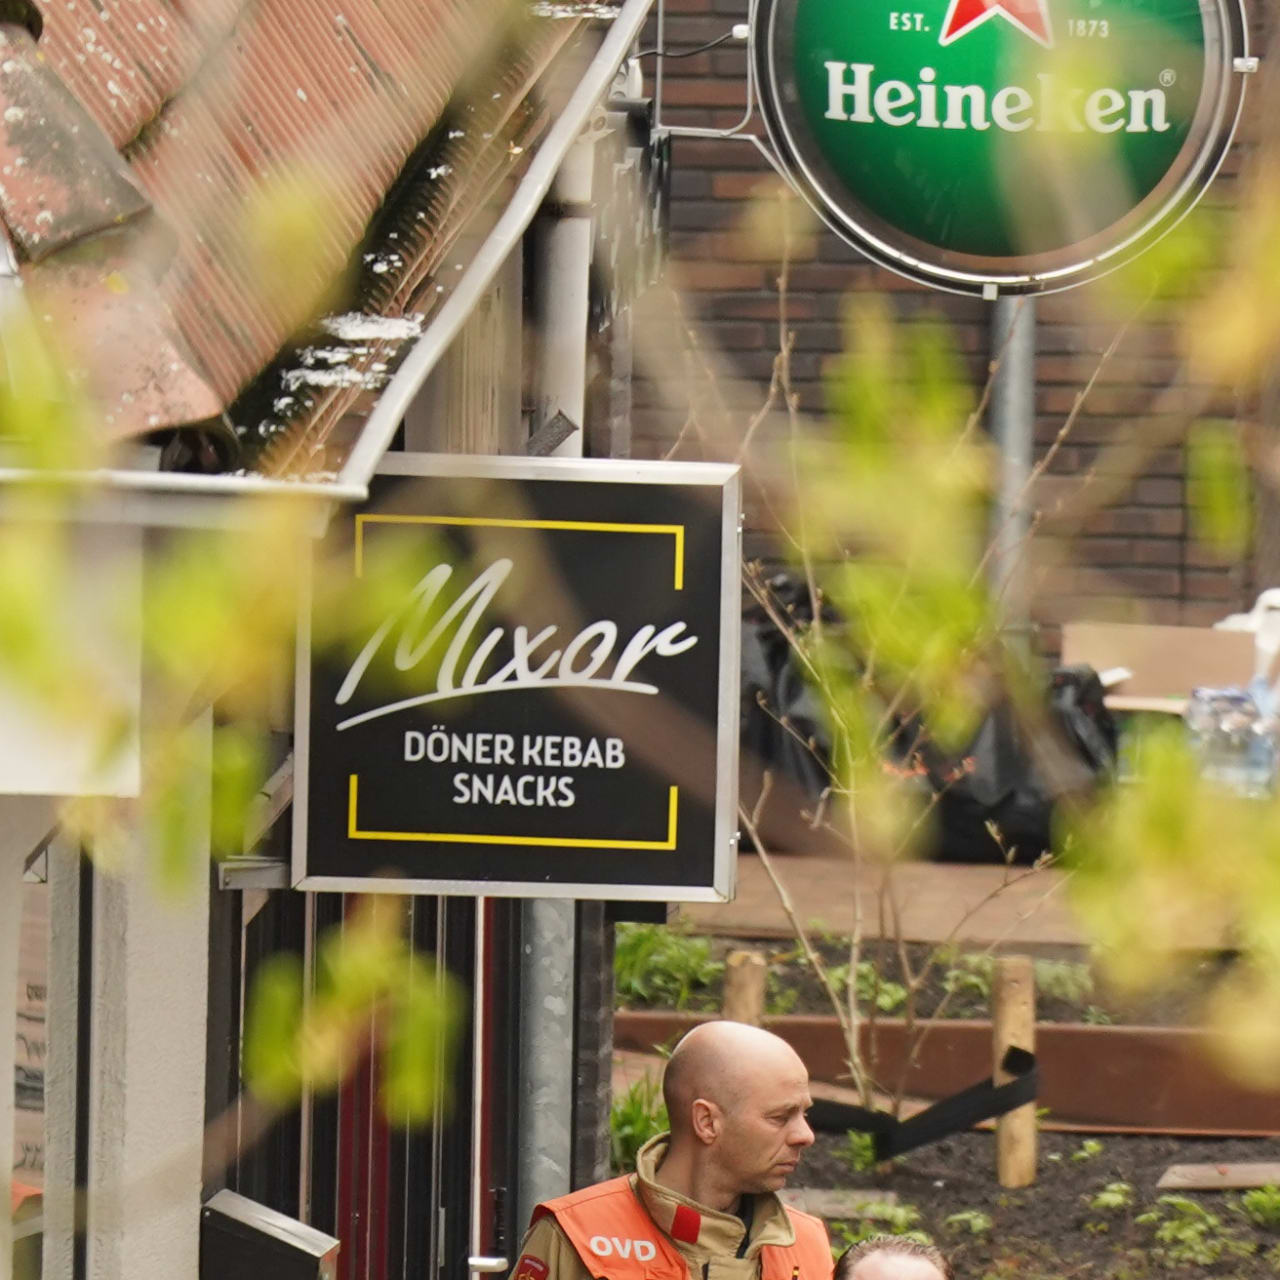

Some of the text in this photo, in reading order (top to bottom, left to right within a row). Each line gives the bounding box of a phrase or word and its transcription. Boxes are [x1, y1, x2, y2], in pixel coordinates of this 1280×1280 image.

[889, 12, 1109, 38] EST. 1873
[824, 60, 1171, 133] Heineken
[404, 724, 626, 769] DÖNER KEBAB
[452, 772, 576, 808] SNACKS
[590, 1235, 657, 1262] OVD
